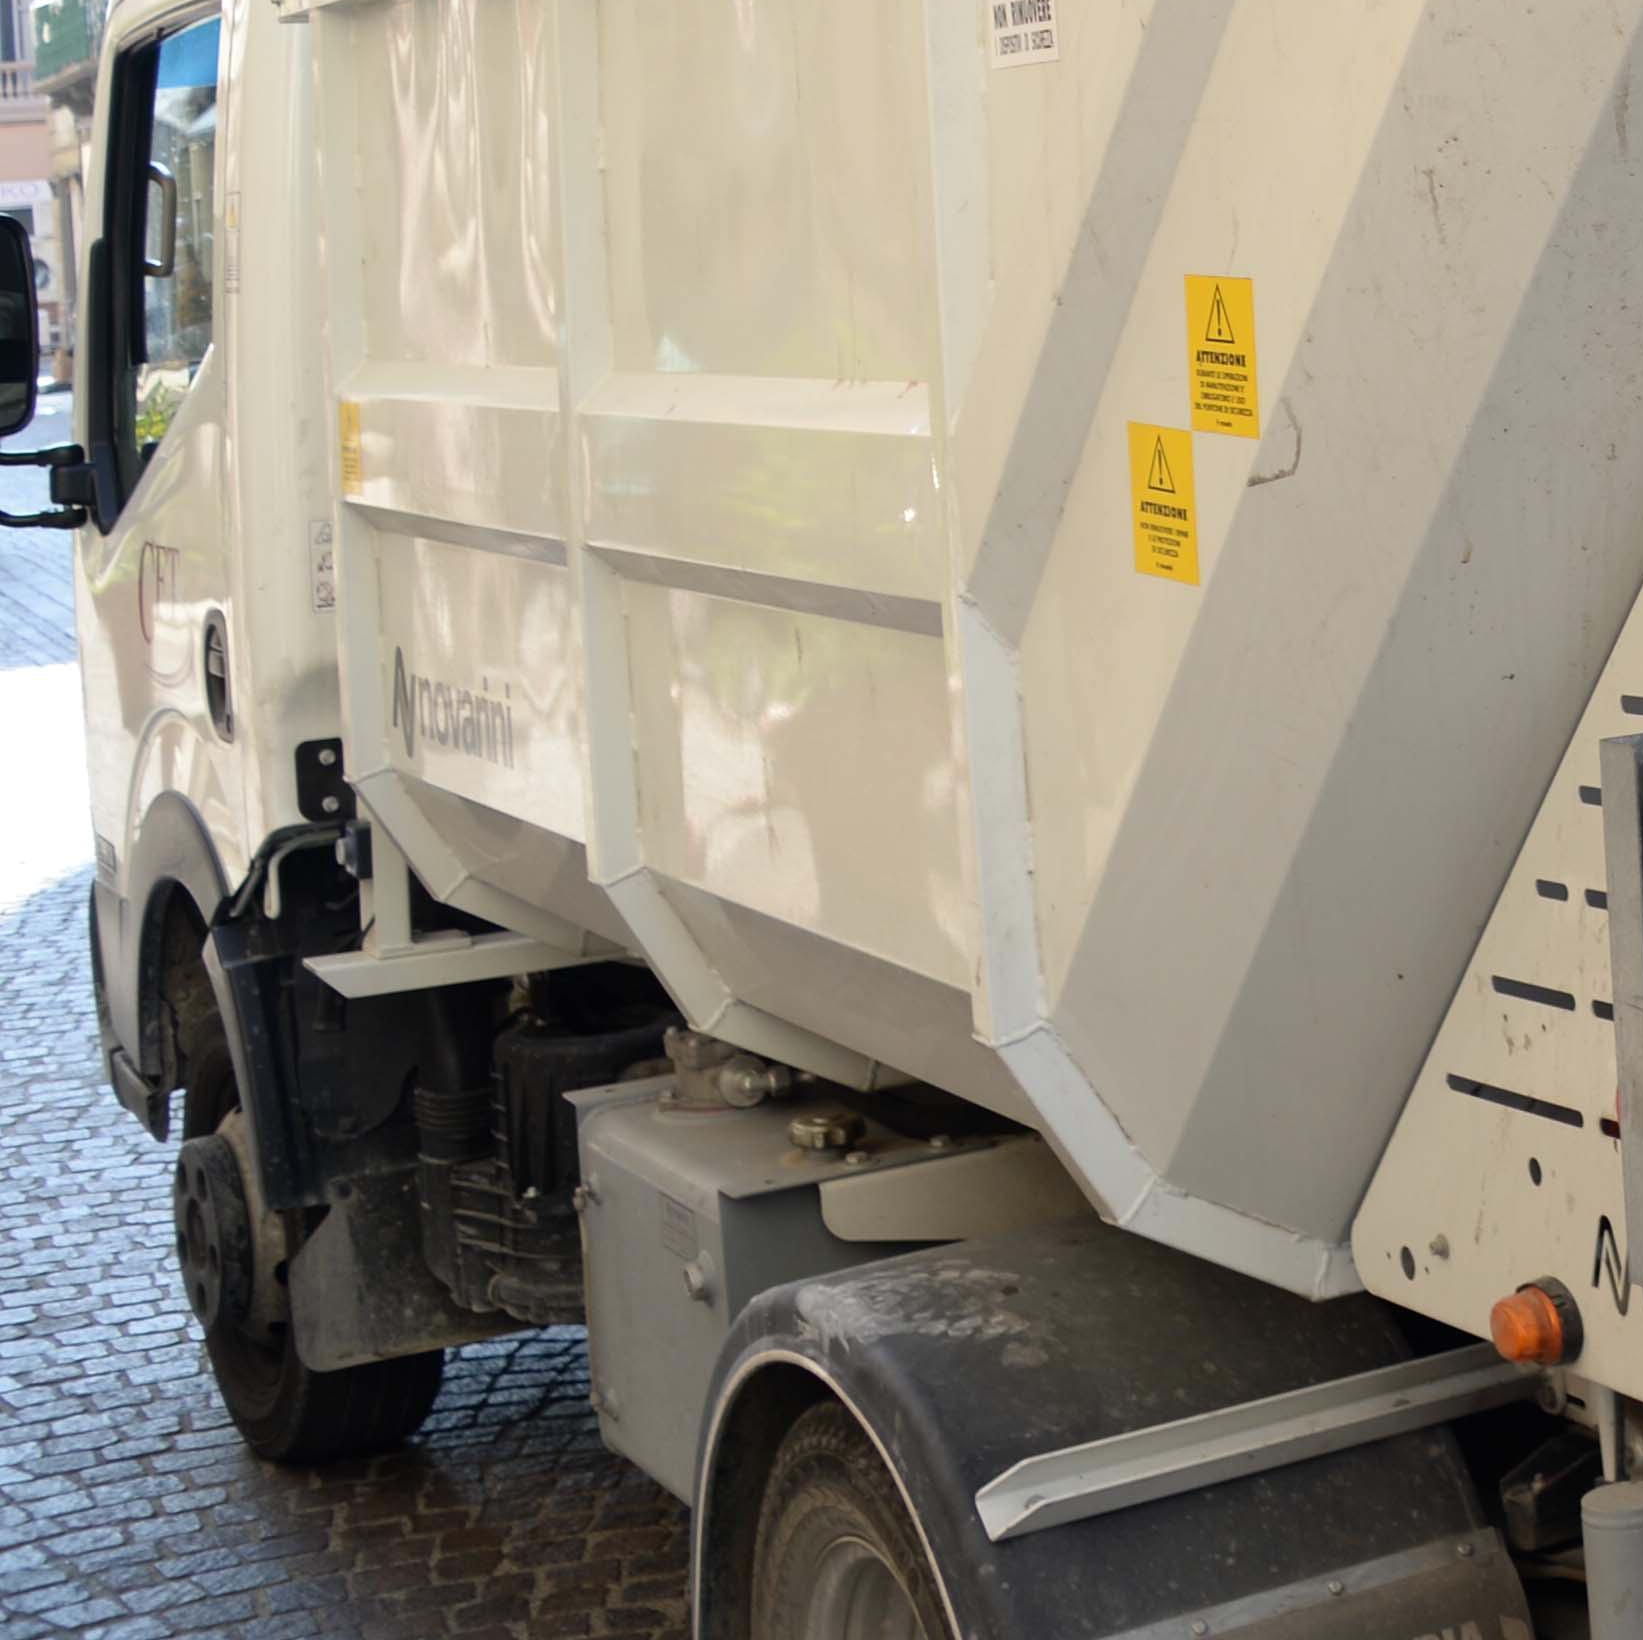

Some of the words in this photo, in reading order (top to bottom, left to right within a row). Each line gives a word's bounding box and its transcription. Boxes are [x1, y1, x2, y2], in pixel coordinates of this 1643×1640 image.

[1195, 349, 1247, 368] ATTENZIONE
[1139, 501, 1188, 521] ATTENZIONE
[418, 675, 514, 770] novarini
